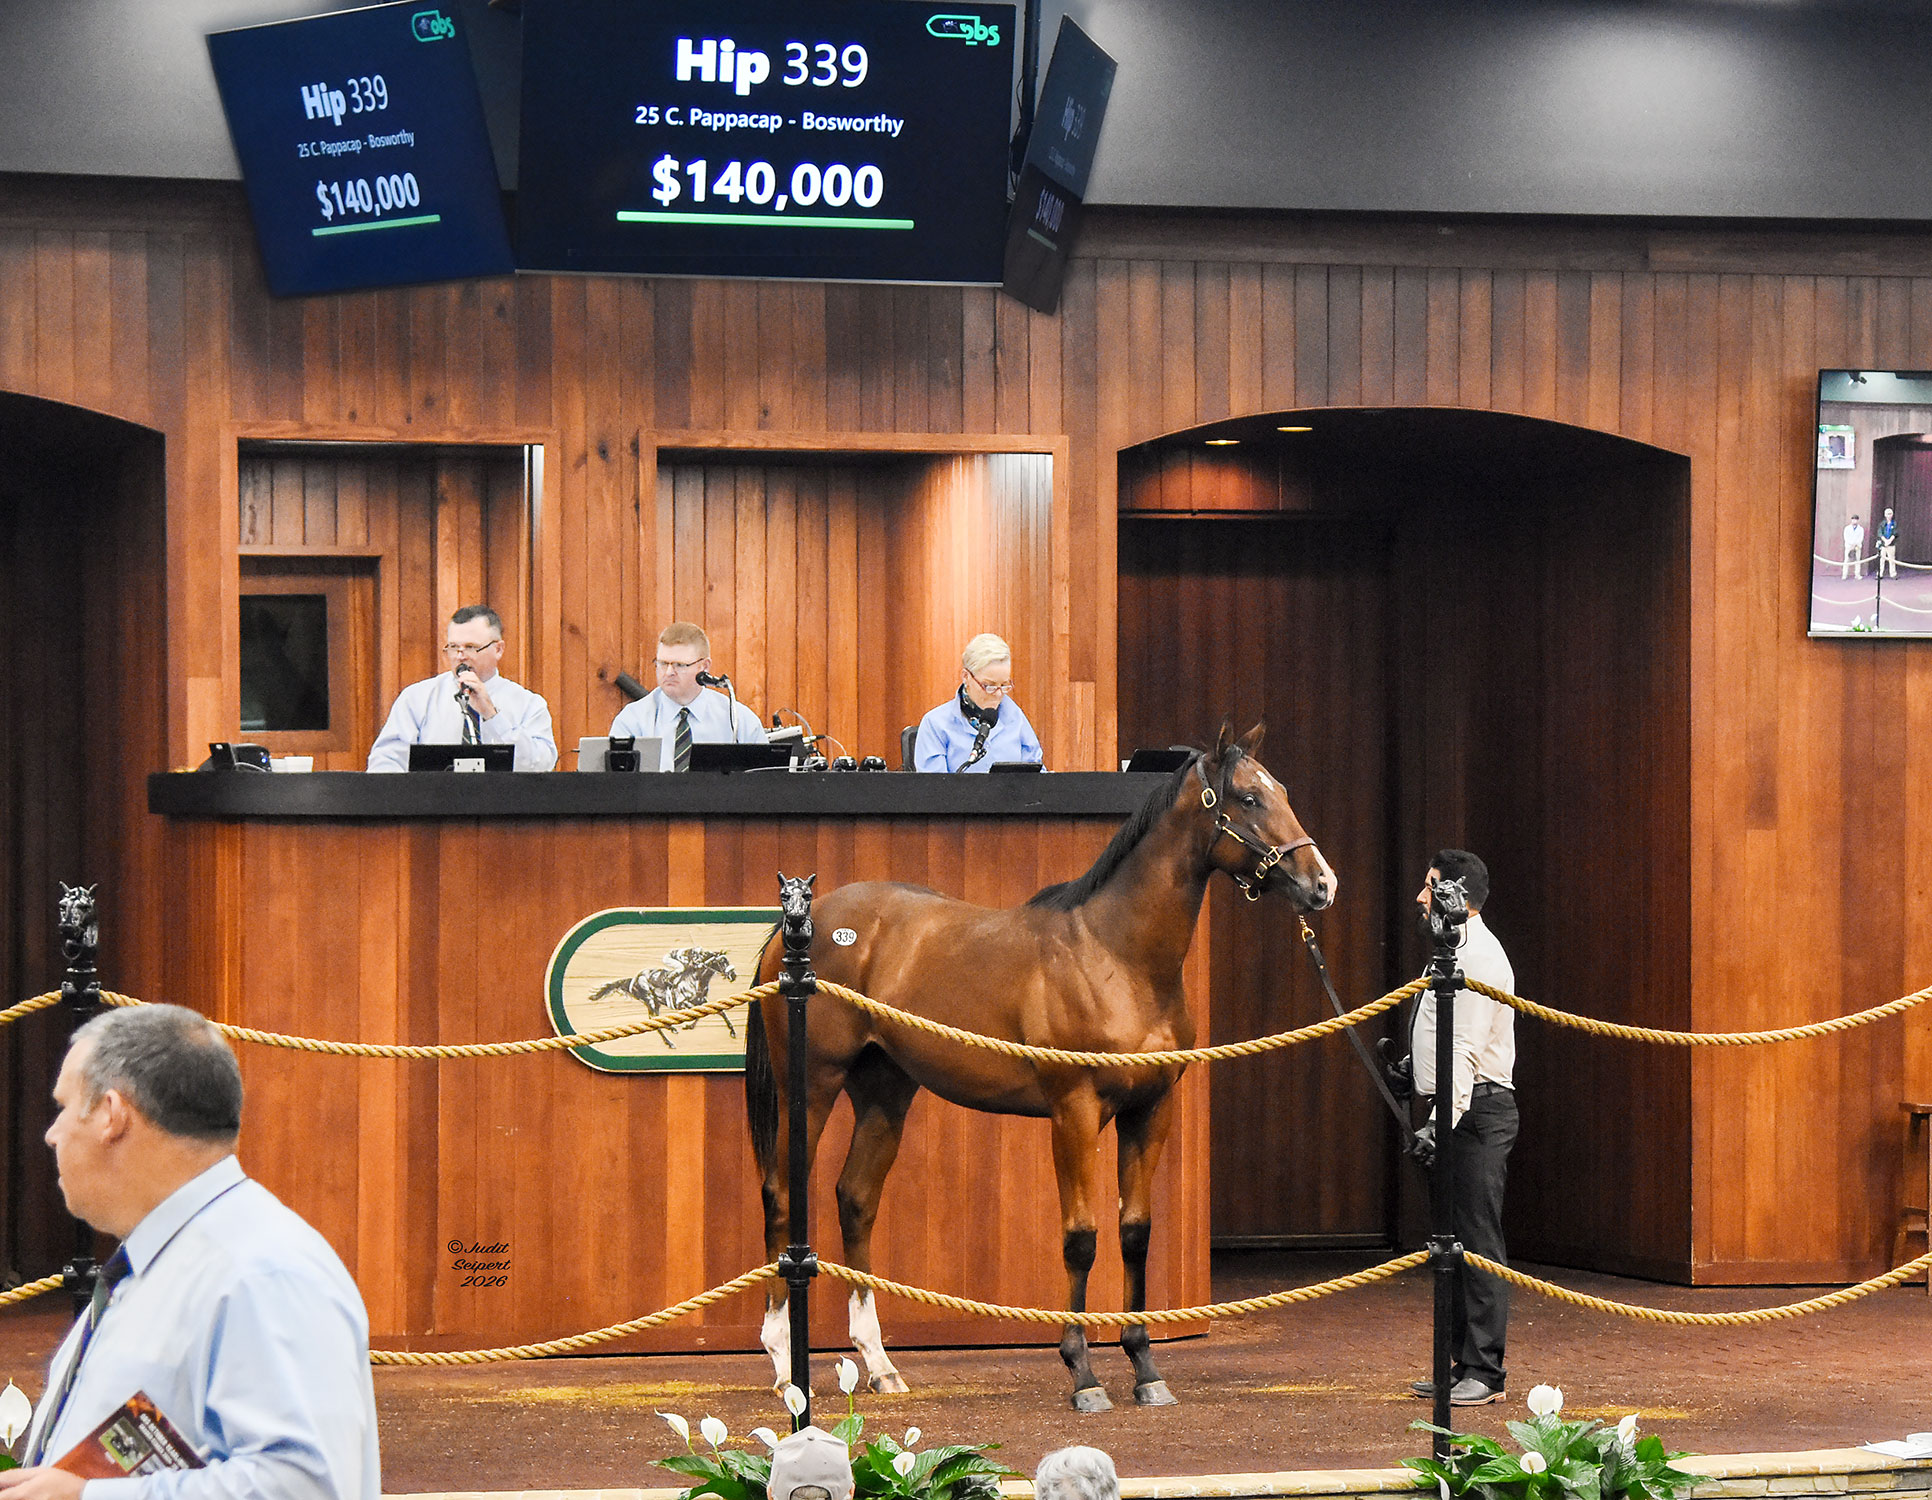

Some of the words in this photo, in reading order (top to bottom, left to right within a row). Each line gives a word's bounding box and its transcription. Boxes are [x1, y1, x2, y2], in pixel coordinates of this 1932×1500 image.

[674, 38, 771, 96] Hip
[782, 42, 869, 88] 339
[301, 82, 347, 126] Hip
[347, 74, 389, 113] 339
[635, 105, 660, 126] 25
[664, 107, 684, 126] C.
[689, 108, 783, 133] Pappacap
[802, 112, 904, 137] Bosworthy
[297, 143, 310, 157] 25
[320, 139, 362, 156] Pappacap
[368, 129, 415, 148] Bosworthy
[316, 172, 421, 222] $140,000
[651, 154, 884, 211] $140,000
[835, 931, 855, 943] 339
